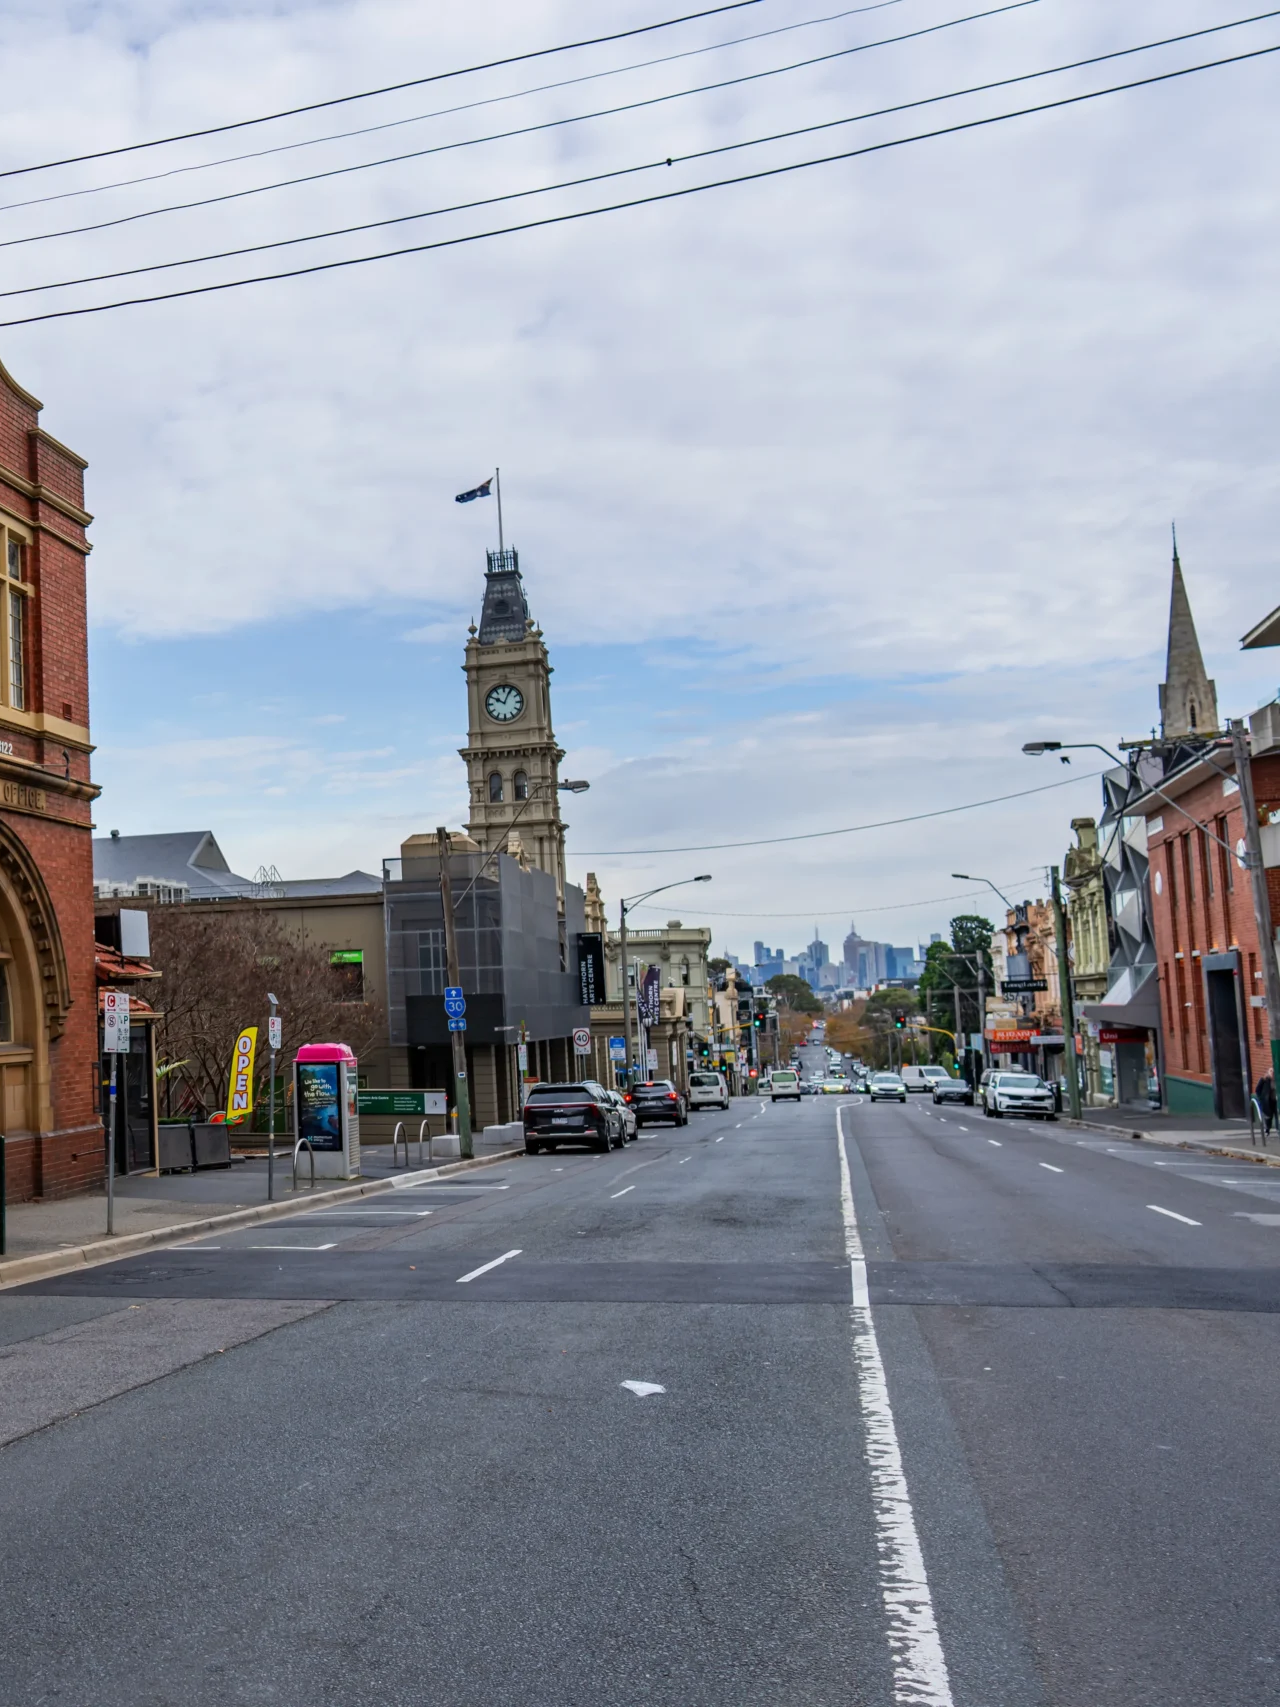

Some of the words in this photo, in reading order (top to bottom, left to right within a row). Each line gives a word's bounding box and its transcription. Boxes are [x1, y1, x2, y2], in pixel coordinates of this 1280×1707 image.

[448, 1001, 462, 1012] 30
[577, 1034, 587, 1042] 40
[232, 1035, 252, 1110] OPEN
